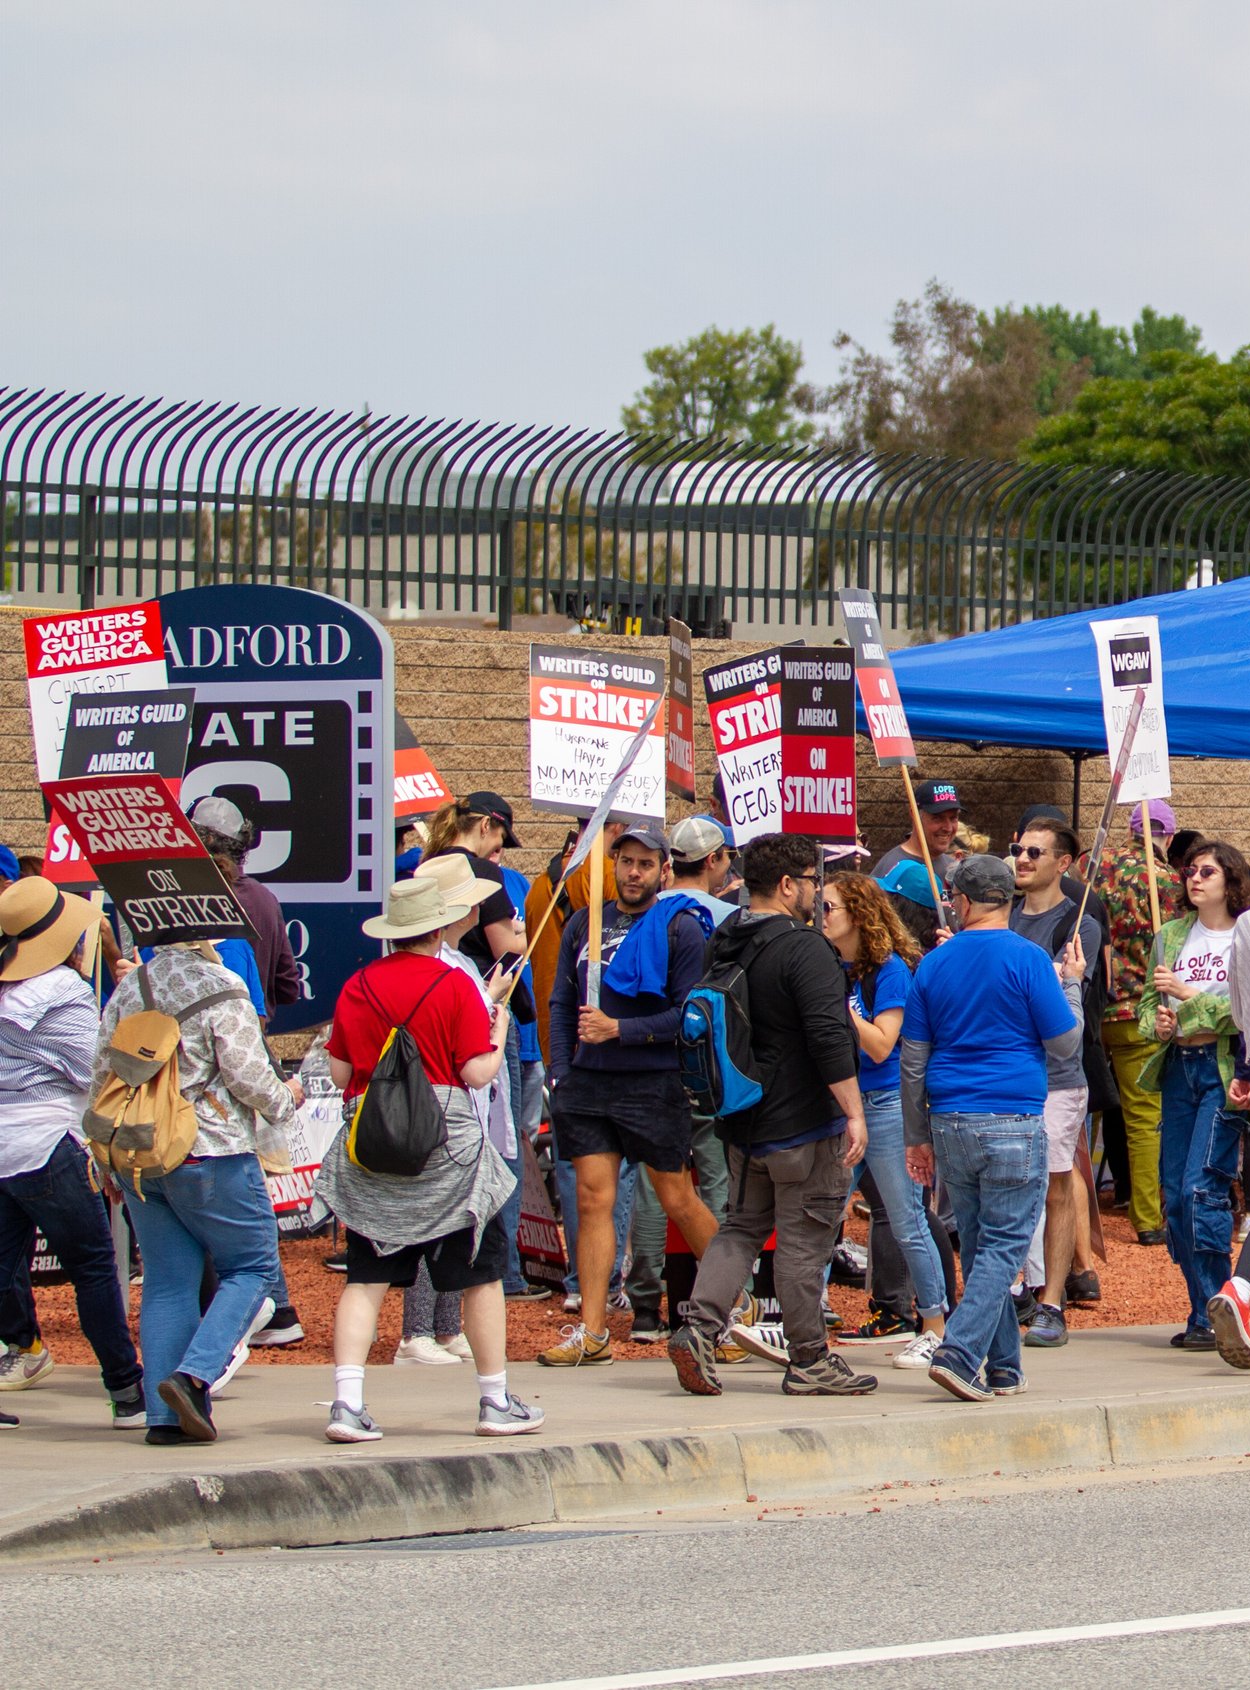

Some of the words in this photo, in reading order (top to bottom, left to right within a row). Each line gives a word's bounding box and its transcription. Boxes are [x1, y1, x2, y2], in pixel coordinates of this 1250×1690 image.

[36, 610, 147, 639] WRITERS
[41, 631, 118, 654] GUILD
[118, 630, 144, 644] OF
[37, 640, 153, 671] AMERICA
[1112, 651, 1150, 672] WGAW
[539, 656, 609, 678] WRITERS
[611, 664, 656, 685] GUILD
[708, 659, 767, 692] WRITERS
[784, 661, 824, 680] WRITERS
[824, 662, 852, 681] GUILD
[48, 673, 131, 705] CHATGPT
[590, 679, 606, 690] ON
[755, 682, 769, 696] ON
[812, 686, 823, 702] OF
[75, 706, 140, 727] WRITERS
[141, 703, 187, 723] GUILD
[539, 686, 656, 730] STRIKE!
[797, 708, 838, 727] AMERICA
[117, 731, 135, 746] OF
[189, 710, 315, 747] ATE
[87, 751, 155, 773] AMERICA
[809, 747, 827, 770] ON
[537, 765, 558, 780] NO
[56, 786, 165, 813] WRITERS
[534, 782, 561, 796] GIVE
[566, 787, 580, 798] US
[783, 776, 854, 816] STRIKE!
[732, 787, 777, 825] CEOs
[77, 808, 151, 833] GUILD
[150, 812, 174, 827] OF
[180, 760, 292, 883] C
[87, 828, 197, 854] AMERICA
[147, 869, 182, 892] ON
[125, 895, 245, 933] STRIKE
[1188, 952, 1212, 968] OUT
[278, 1215, 302, 1231] GUILD
[30, 1255, 62, 1272] TERS
